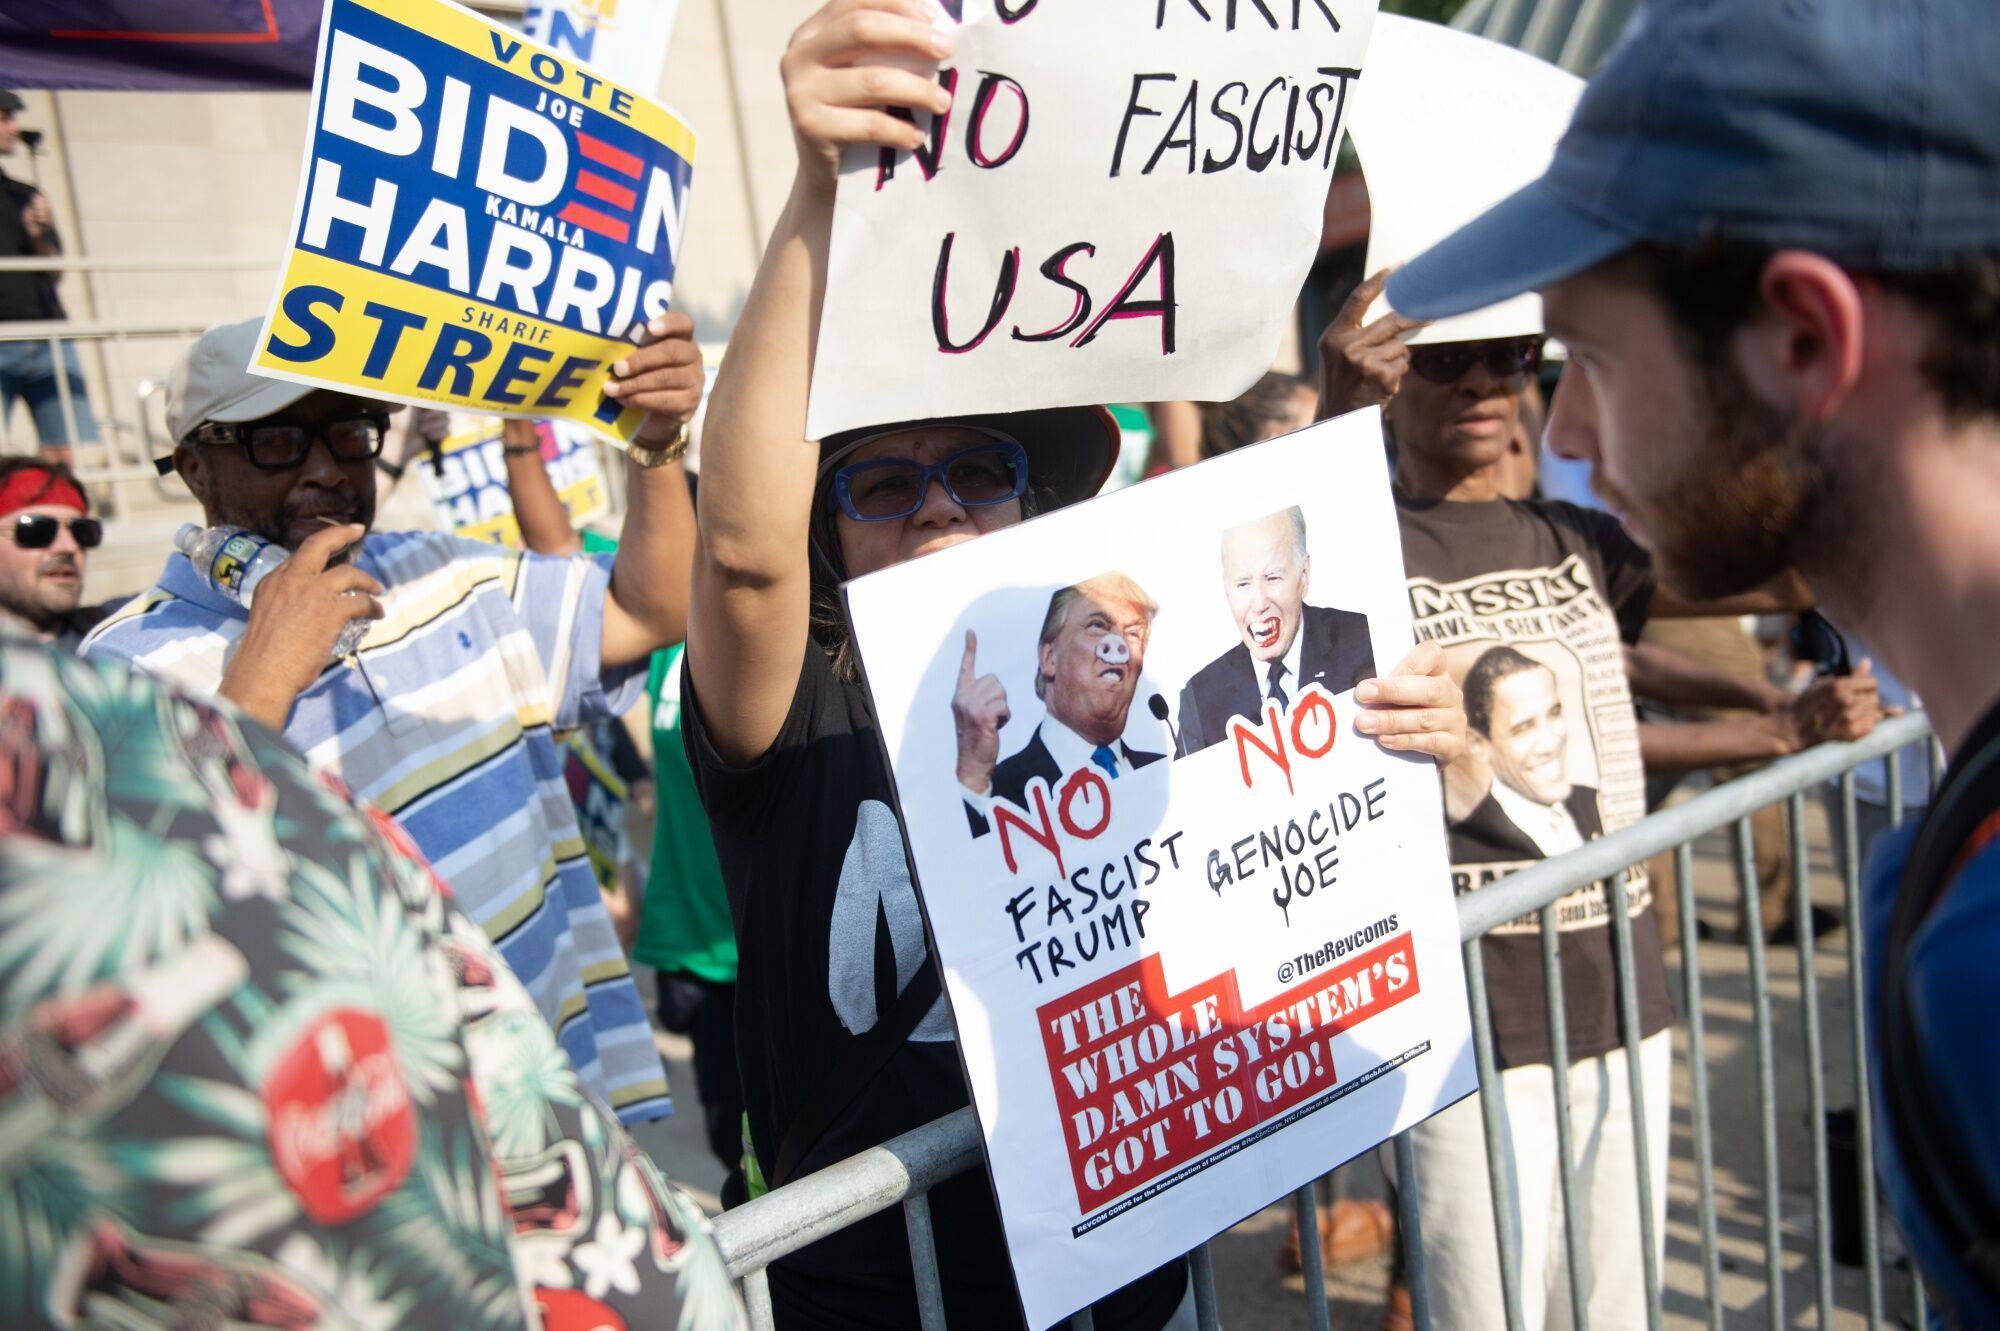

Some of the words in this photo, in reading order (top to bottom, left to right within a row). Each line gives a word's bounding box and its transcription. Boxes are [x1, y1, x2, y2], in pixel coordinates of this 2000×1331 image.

[489, 30, 637, 120] VOTE
[535, 92, 584, 128] JOE
[1109, 67, 1362, 178] FASCIST
[322, 29, 690, 265] BIDEN
[485, 195, 584, 249] KAMALA
[461, 306, 553, 344] SHARIF
[932, 231, 1179, 355] USA
[1234, 690, 1337, 795] NO
[992, 766, 1113, 880] NO
[1206, 777, 1389, 897] GENOCIDE
[1005, 831, 1185, 943] FASCIST
[1273, 845, 1340, 928] JOE
[1016, 900, 1151, 985] TRUMP
[1276, 914, 1399, 984] @TheRevcoms
[1051, 980, 1147, 1055] THE
[1062, 995, 1224, 1100] WHOLE
[1072, 1054, 1200, 1150] DAMN
[1214, 951, 1412, 1078] SYSTEM'S
[1084, 1117, 1171, 1192] GOT
[1184, 1086, 1243, 1140] TO
[1255, 1041, 1325, 1103] GO!
[1077, 1213, 1108, 1233] REVCOM
[1108, 1200, 1132, 1216] CORPS
[1133, 1194, 1143, 1203] for
[1144, 1187, 1156, 1198] the
[1156, 1165, 1201, 1190] Emancipation
[1209, 1143, 1240, 1163] Humanity
